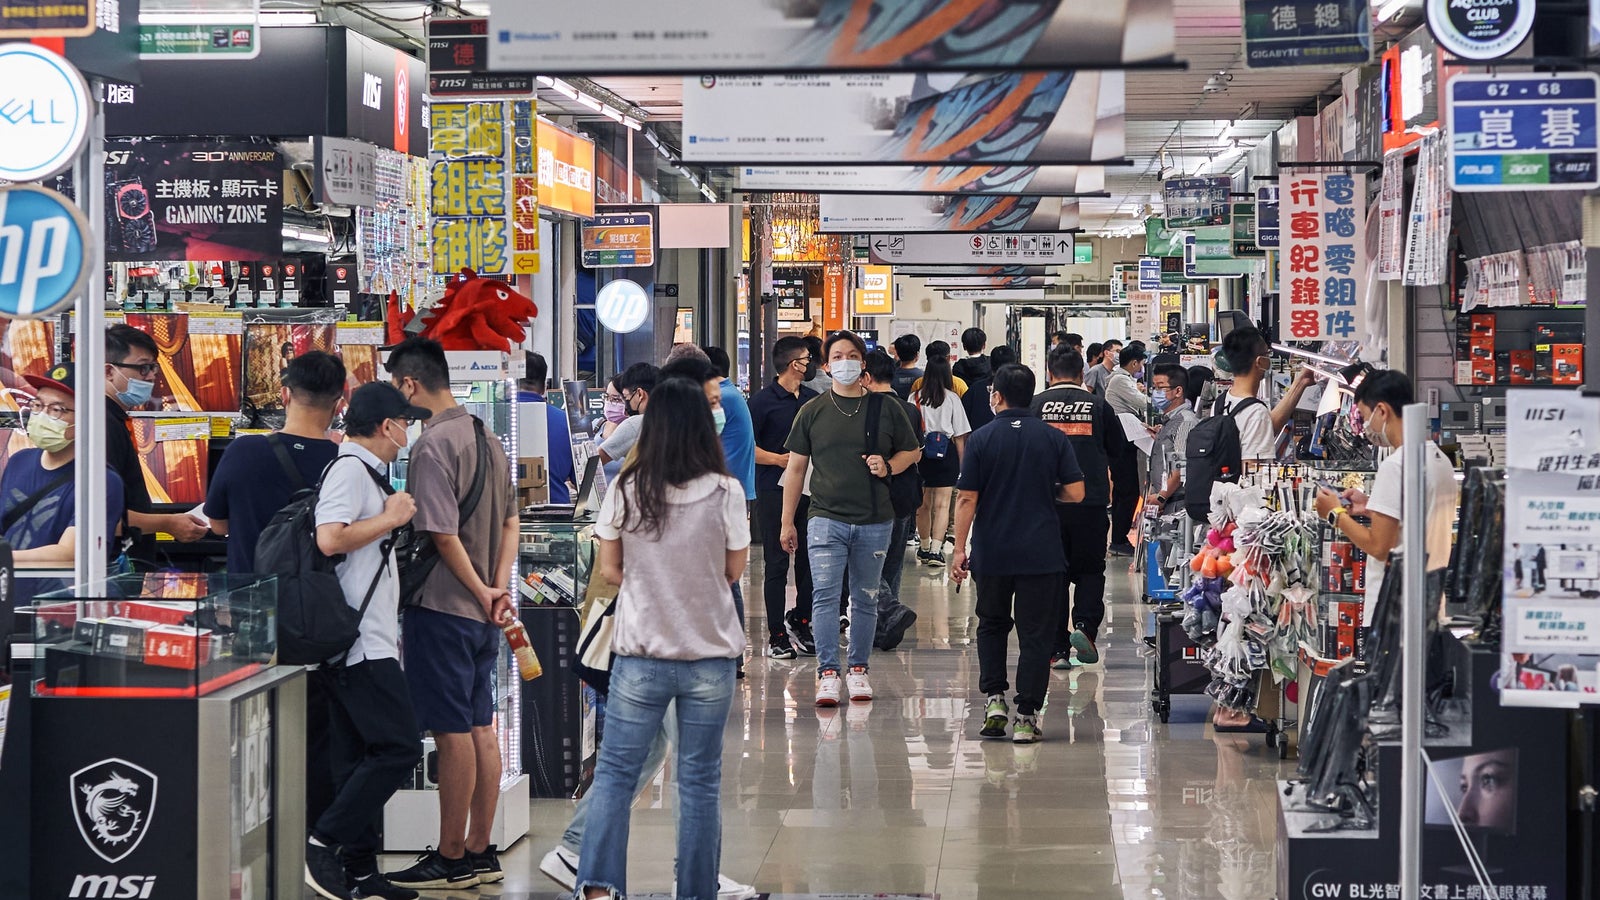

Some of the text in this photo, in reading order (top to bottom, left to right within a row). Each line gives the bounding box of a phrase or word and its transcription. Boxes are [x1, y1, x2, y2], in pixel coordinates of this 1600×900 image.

[1466, 8, 1500, 21] CLUB
[1252, 48, 1300, 59] GIGABYTE
[362, 72, 382, 110] msi
[439, 79, 466, 88] msi
[1486, 84, 1509, 96] 67
[1538, 83, 1561, 95] 68
[0, 98, 65, 124] ELL
[430, 103, 504, 158] 電腦
[228, 152, 275, 162] ANNIVERSARY
[1459, 164, 1494, 175] ASUS
[1509, 164, 1543, 175] acer
[431, 159, 505, 215] 組裝
[166, 205, 267, 224] GAMING ZONE
[431, 218, 507, 273] 維修
[1323, 174, 1357, 338] 電腦零組件
[1289, 179, 1320, 338] 行車紀錄器
[604, 281, 642, 331] hp
[1041, 401, 1094, 413] CReTE
[69, 874, 157, 900] msi
[1312, 884, 1341, 898] GW
